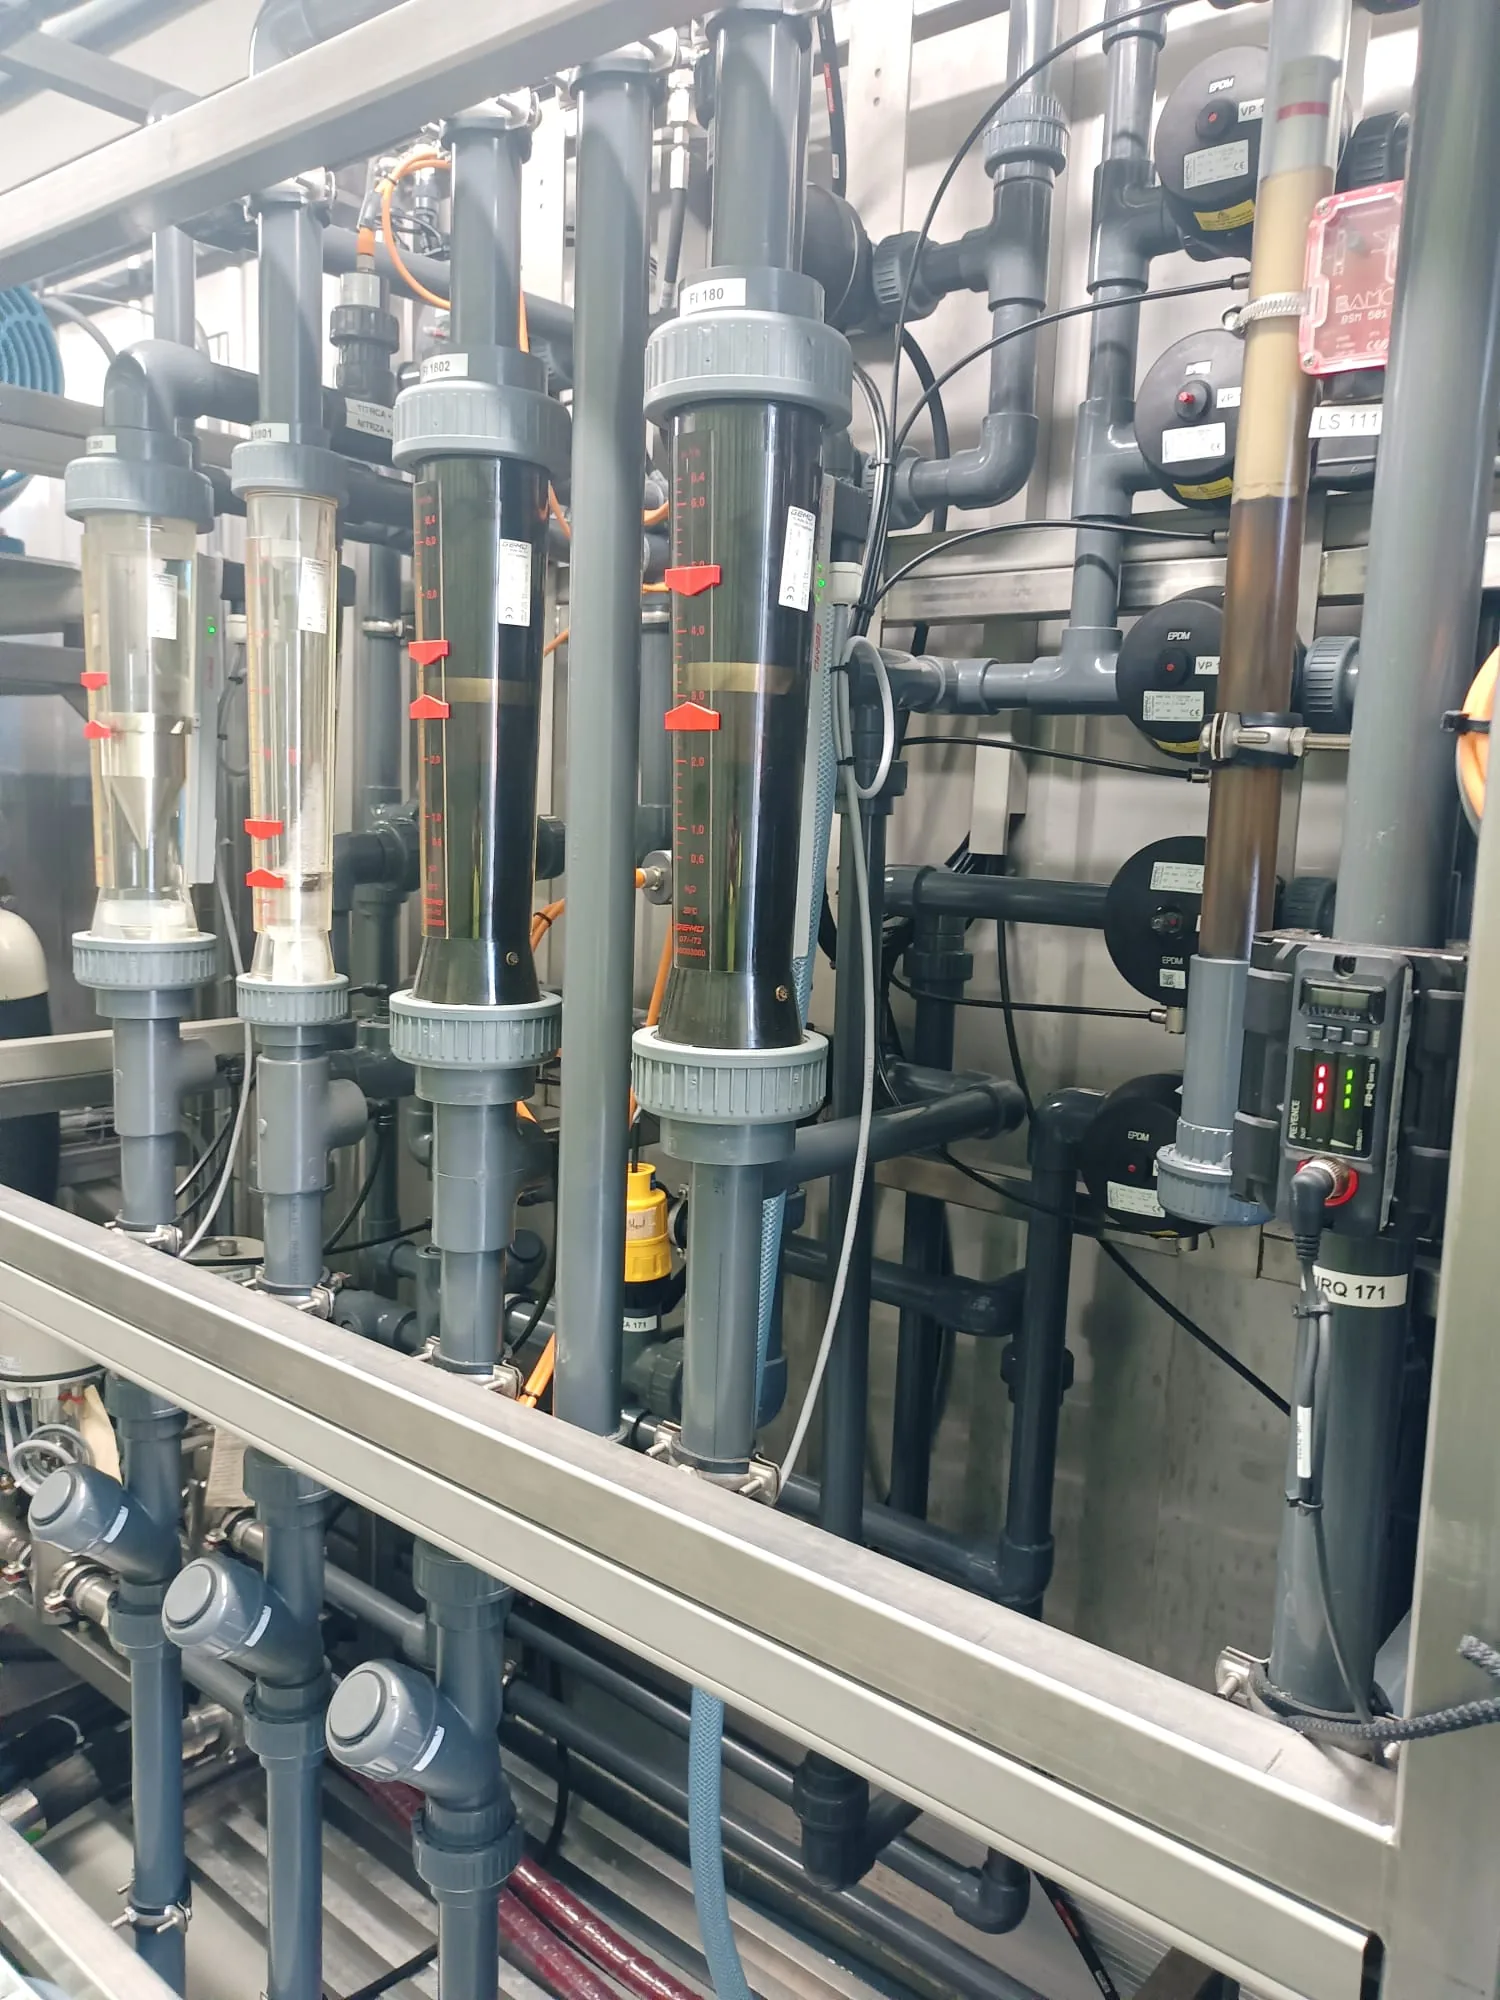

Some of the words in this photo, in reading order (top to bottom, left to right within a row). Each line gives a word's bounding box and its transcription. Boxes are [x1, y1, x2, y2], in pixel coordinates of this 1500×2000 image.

[1240, 104, 1256, 117] VP
[689, 292, 699, 305] FI
[703, 287, 724, 303] 180
[1318, 413, 1340, 430] LS
[1350, 412, 1378, 428] 111
[1167, 631, 1191, 641] EPDM
[1197, 661, 1213, 670] VP
[1161, 956, 1183, 965] EPDM
[1288, 1099, 1300, 1139] KEYENCE
[1127, 1130, 1150, 1141] EPDM
[1355, 1284, 1386, 1300] 171
[633, 1321, 647, 1329] 171
